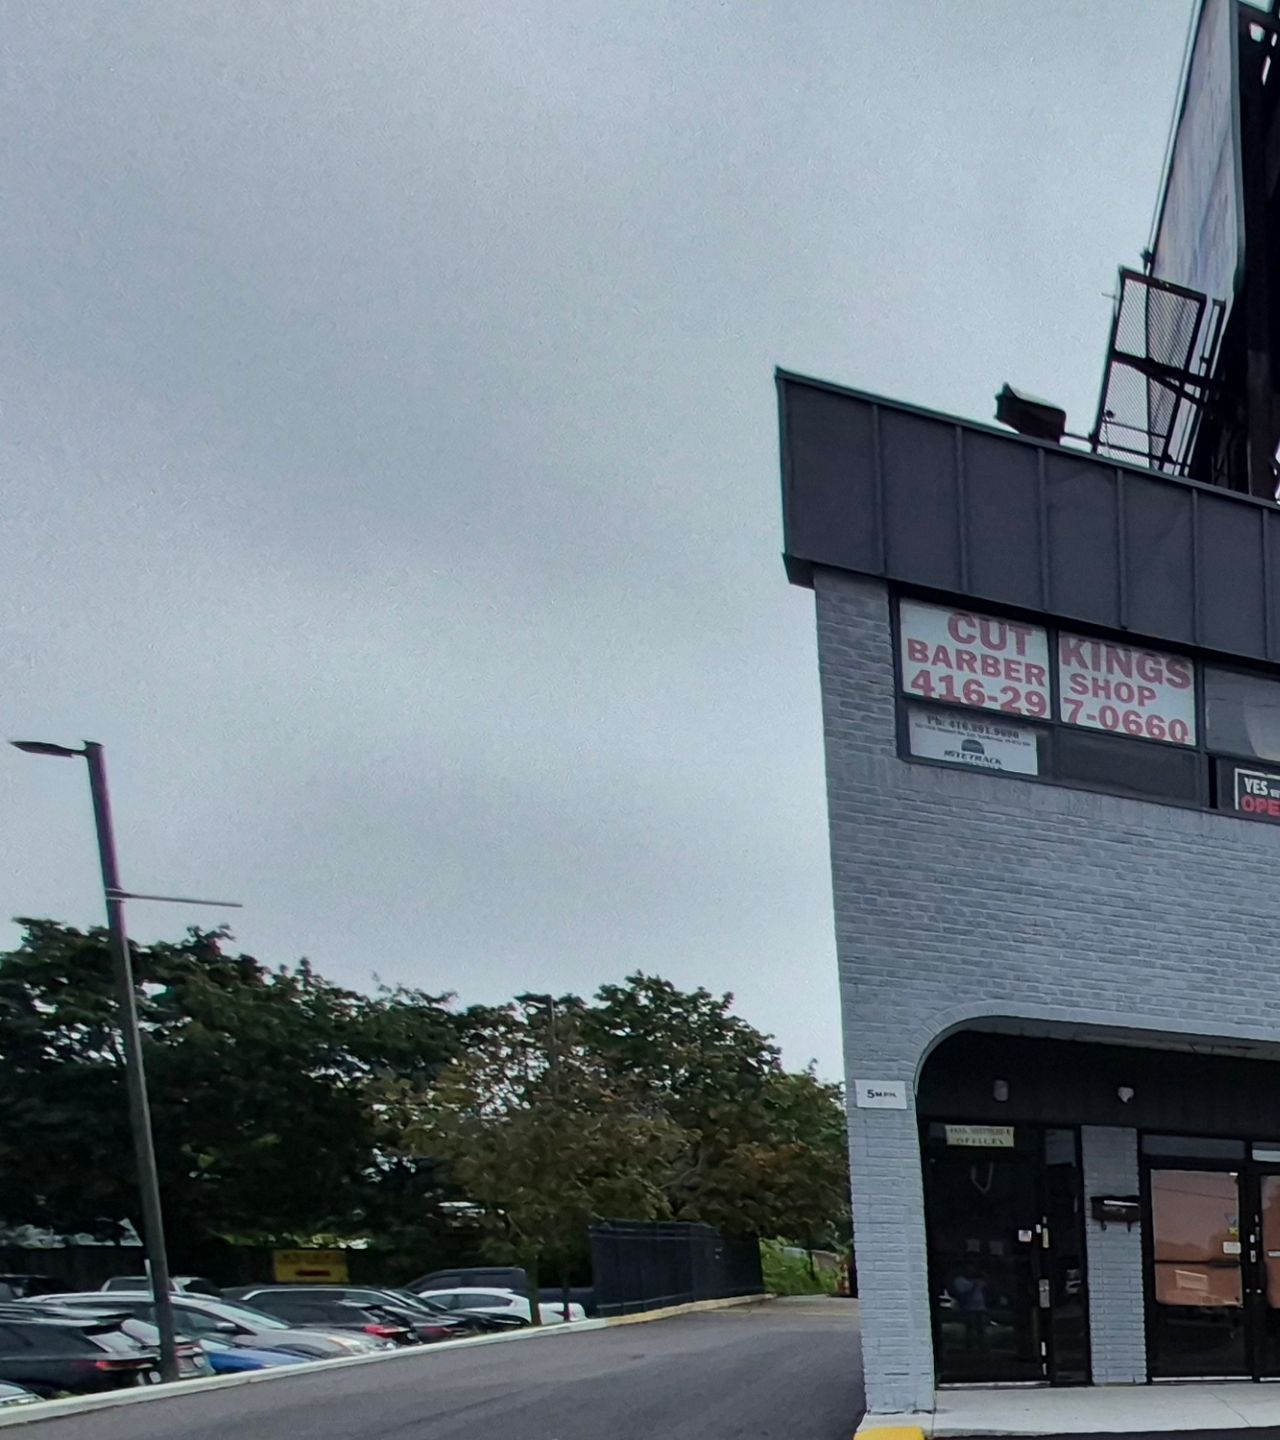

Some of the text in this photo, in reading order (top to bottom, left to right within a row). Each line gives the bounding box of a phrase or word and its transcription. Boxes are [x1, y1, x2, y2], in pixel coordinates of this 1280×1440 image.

[907, 638, 1157, 707] BARBER SHOP
[948, 610, 1192, 690] CUT KINGS
[1244, 777, 1268, 796] YES
